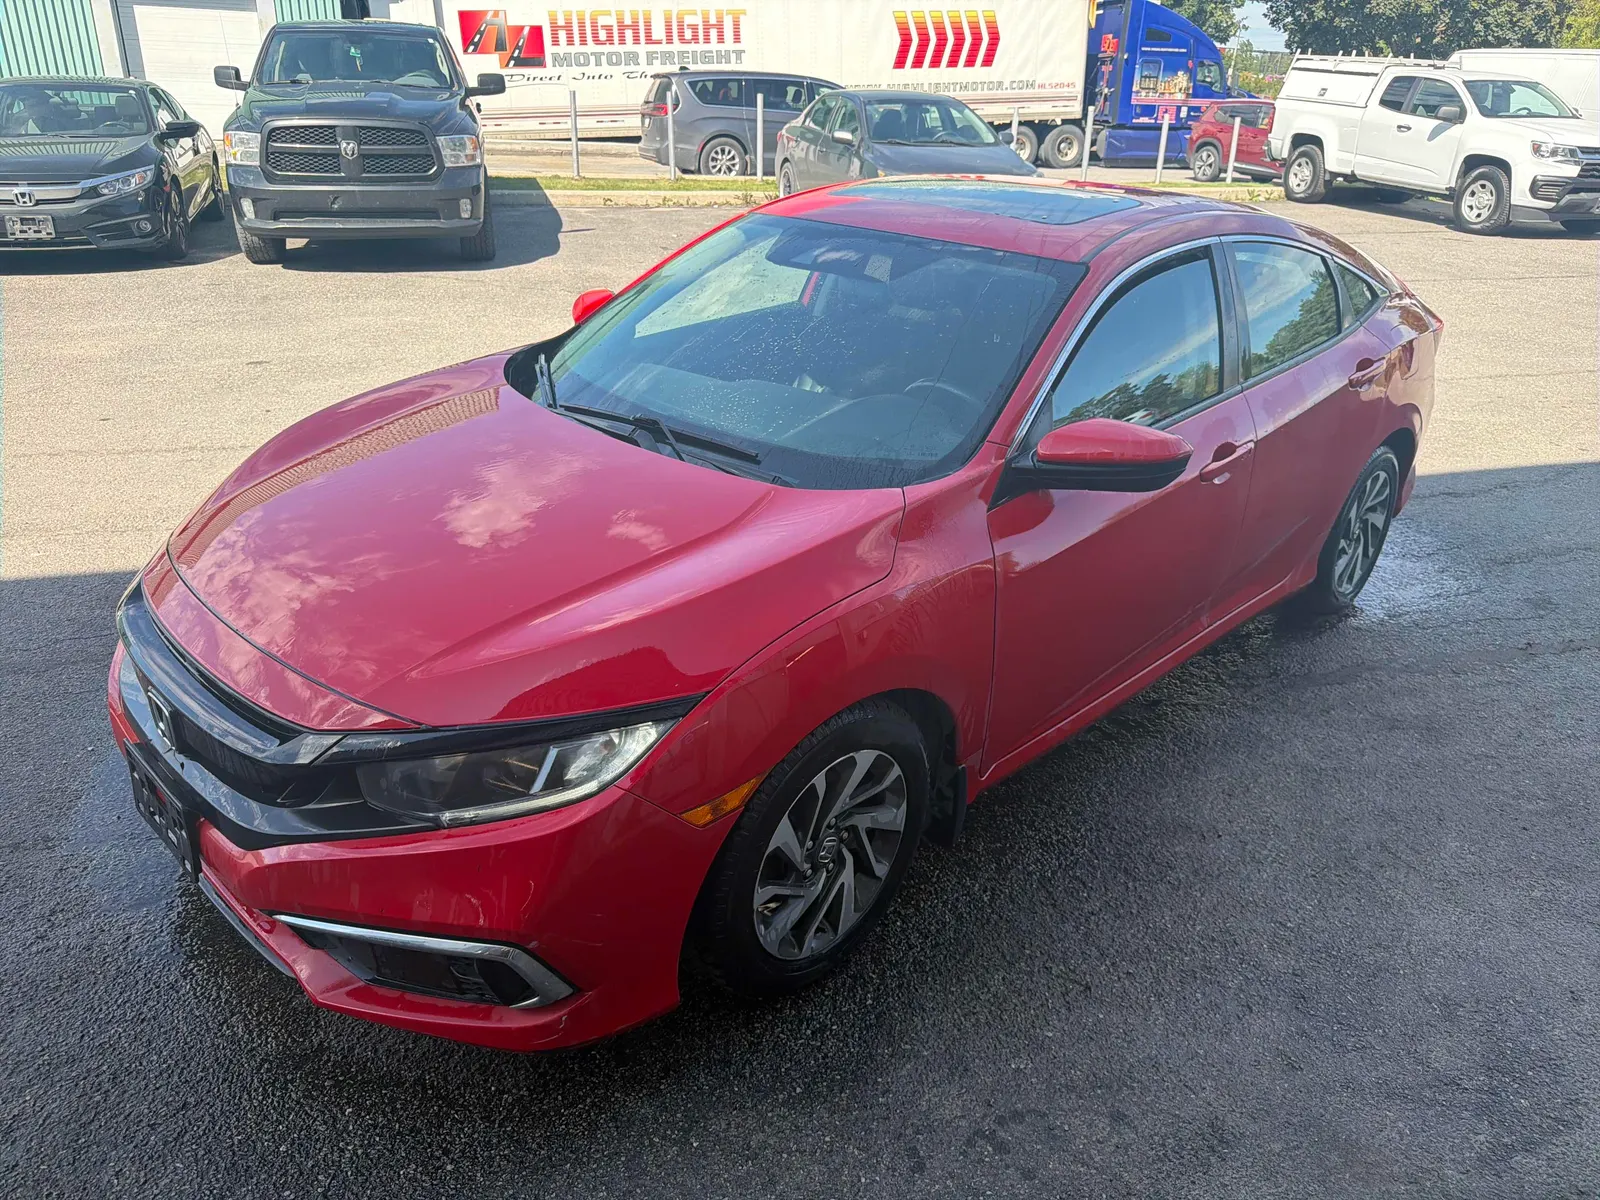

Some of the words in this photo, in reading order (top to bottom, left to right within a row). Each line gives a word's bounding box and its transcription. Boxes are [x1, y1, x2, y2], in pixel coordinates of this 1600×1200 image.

[548, 9, 747, 46] HIGHLIGHT
[551, 51, 640, 67] MOTOR
[646, 50, 745, 66] FREIGHT
[505, 73, 562, 82] Direct
[572, 72, 613, 80] Into
[622, 71, 653, 79] Th
